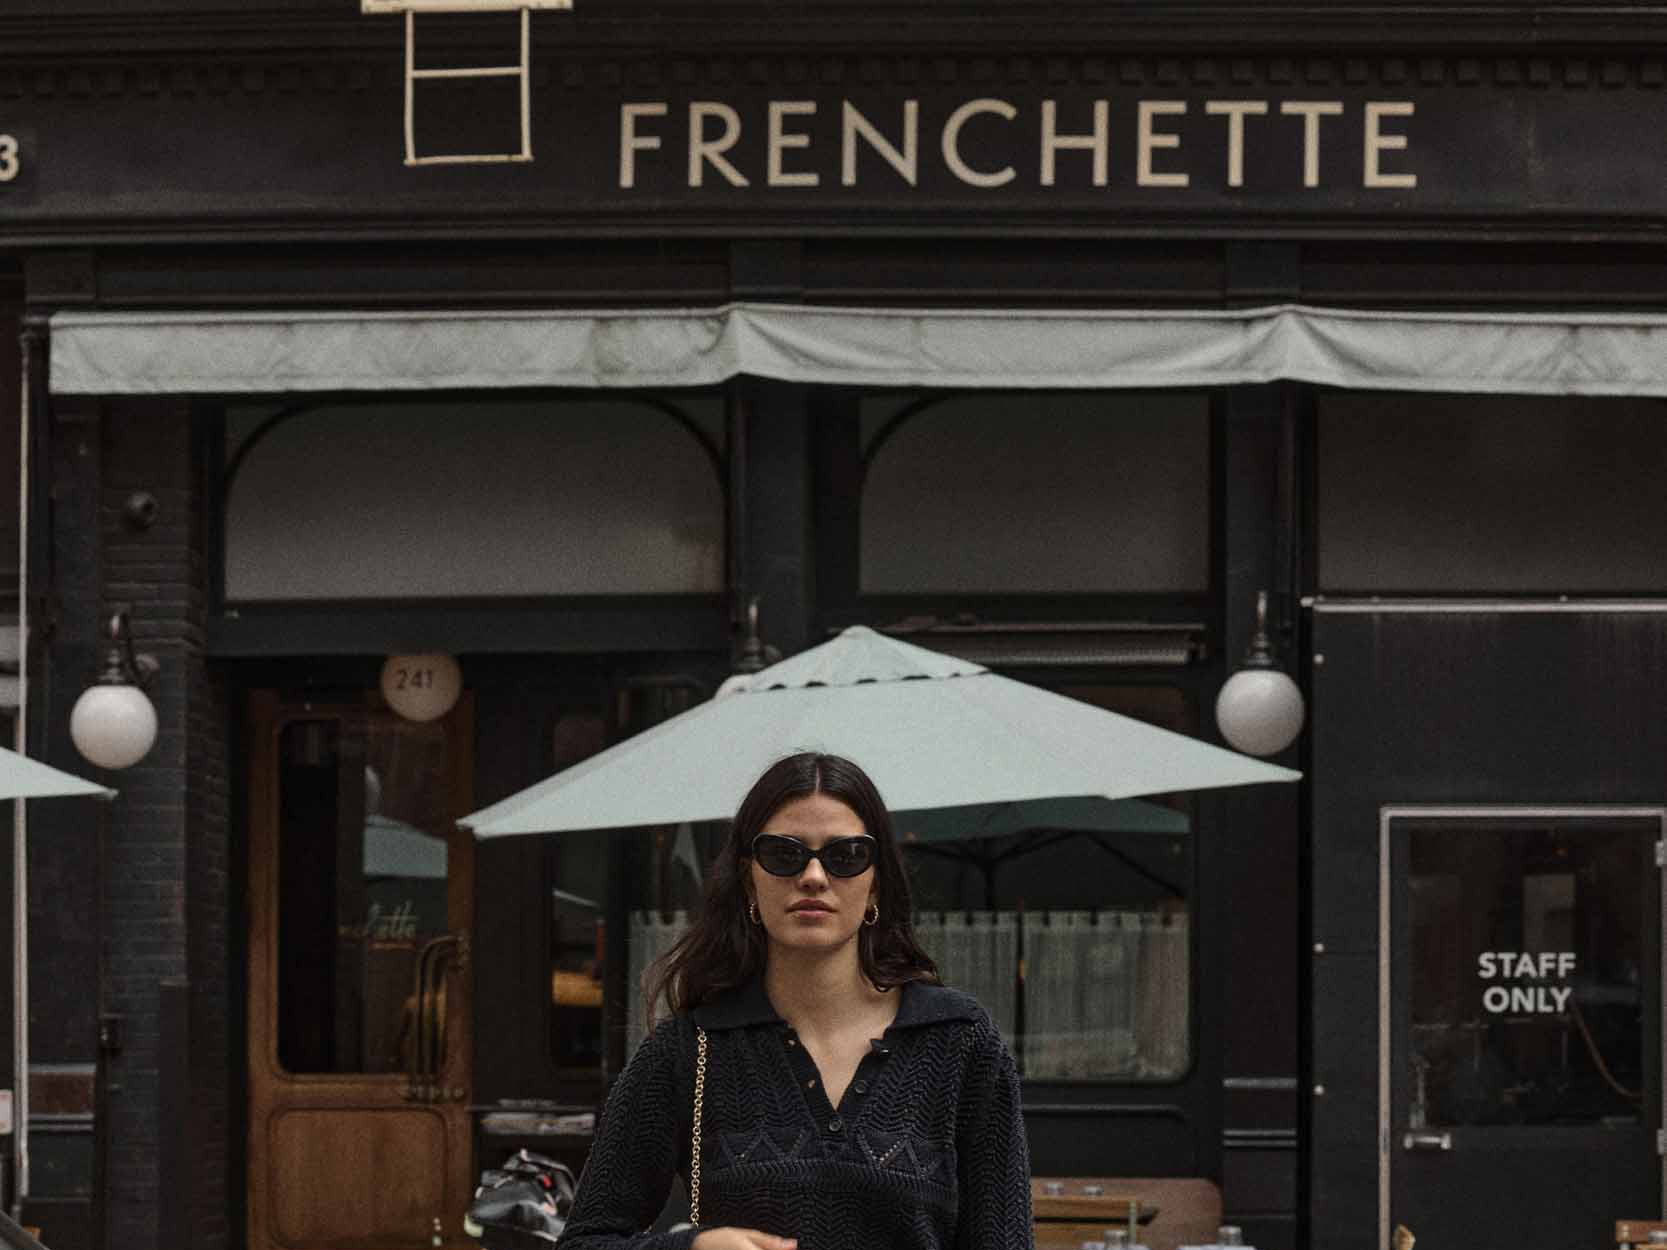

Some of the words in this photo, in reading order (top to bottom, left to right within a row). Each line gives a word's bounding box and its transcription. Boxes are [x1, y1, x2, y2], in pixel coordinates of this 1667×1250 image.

[618, 98, 1419, 189] FRENCHETTE
[396, 667, 434, 689] 241
[1477, 951, 1577, 979] STAFF
[1482, 986, 1572, 1013] ONLY
